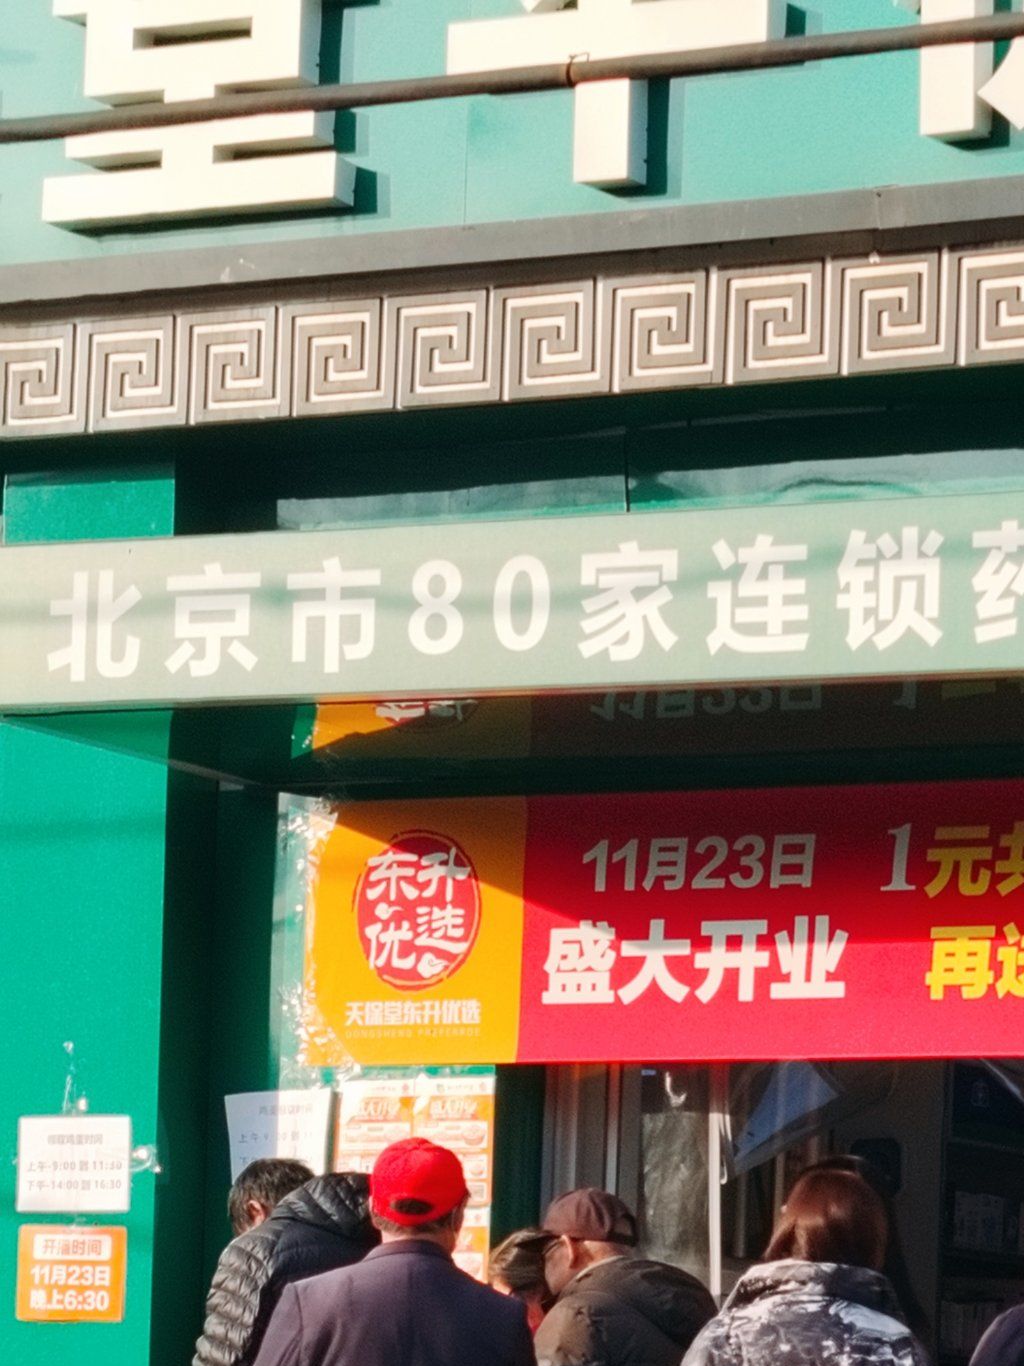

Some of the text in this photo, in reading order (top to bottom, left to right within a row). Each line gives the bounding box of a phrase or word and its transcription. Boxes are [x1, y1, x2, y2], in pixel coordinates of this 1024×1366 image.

[581, 833, 818, 893] 11月23日
[365, 904, 467, 971] 优选
[541, 915, 849, 1006] 盛大开业
[30, 1264, 112, 1287] 11月23日
[30, 1289, 111, 1313] 晚上6:30
